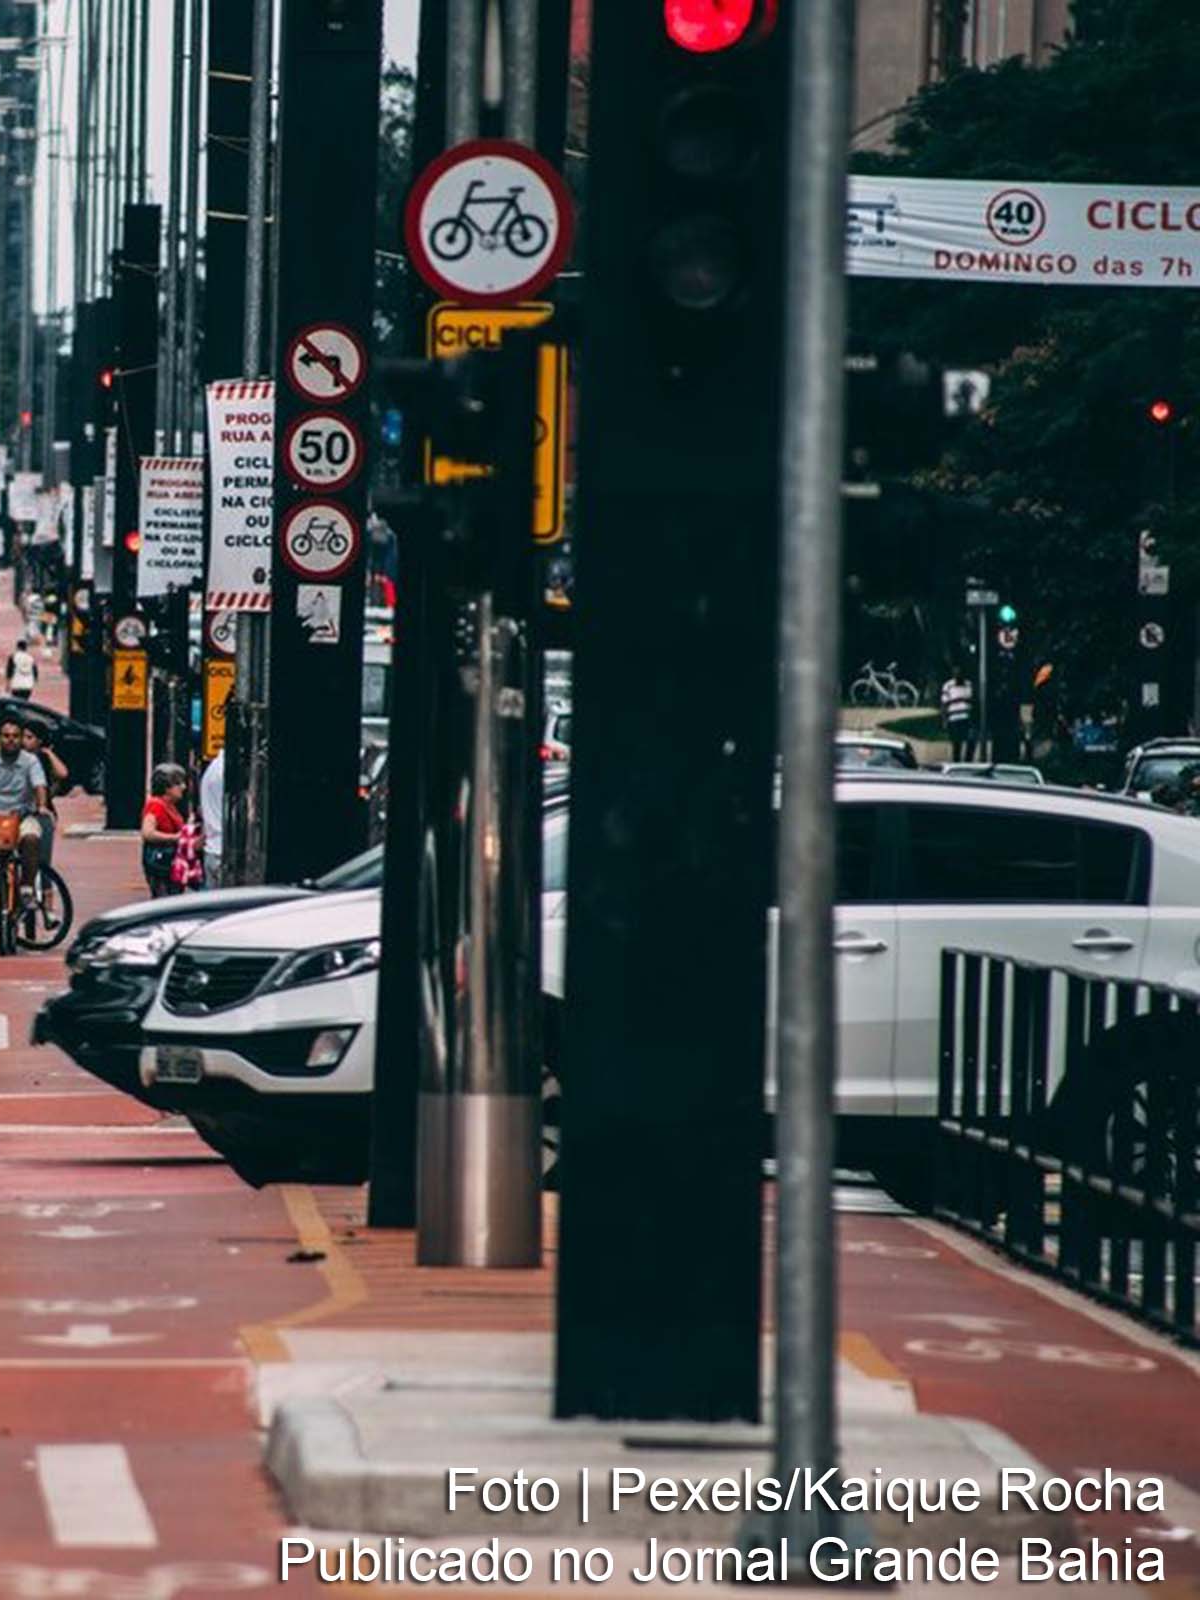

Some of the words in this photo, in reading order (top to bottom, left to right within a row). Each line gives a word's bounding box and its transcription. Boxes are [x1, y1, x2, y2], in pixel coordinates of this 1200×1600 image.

[994, 201, 1035, 225] 40
[934, 250, 1077, 275] DOMINGO
[1093, 254, 1143, 277] das
[1160, 256, 1193, 278] 7h
[438, 324, 499, 348] CICL
[225, 413, 272, 425] PROG
[221, 430, 256, 442] RUA
[299, 430, 349, 465] 50
[234, 456, 272, 469] CICL
[223, 476, 274, 489] PERM
[221, 496, 245, 508] NA
[245, 515, 269, 528] OU
